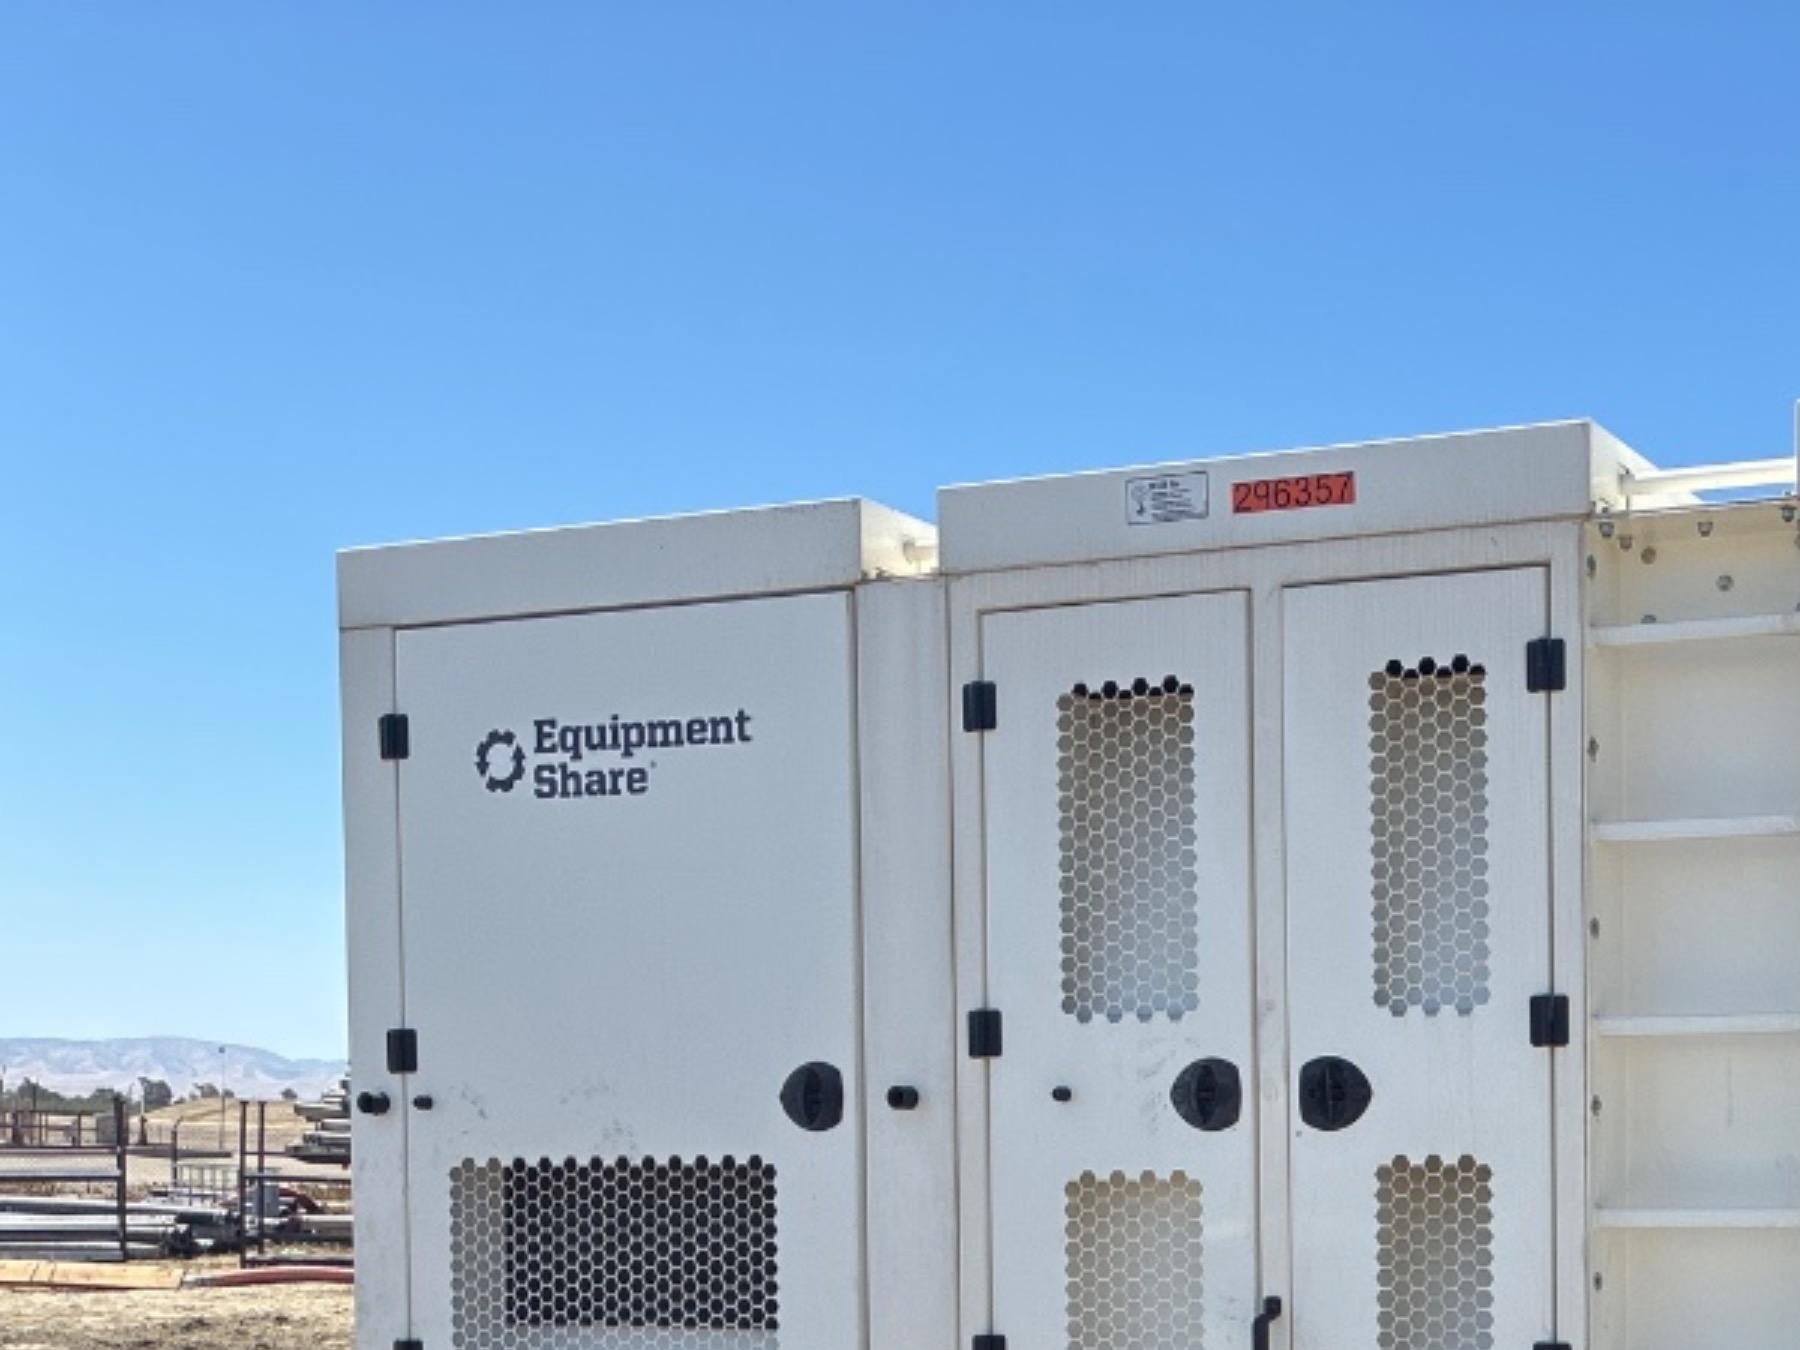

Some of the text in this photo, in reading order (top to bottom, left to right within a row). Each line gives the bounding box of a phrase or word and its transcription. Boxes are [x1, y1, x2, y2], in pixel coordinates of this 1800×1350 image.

[1232, 471, 1354, 513] 296357
[533, 708, 753, 761] Equipment
[533, 761, 650, 799] Share
